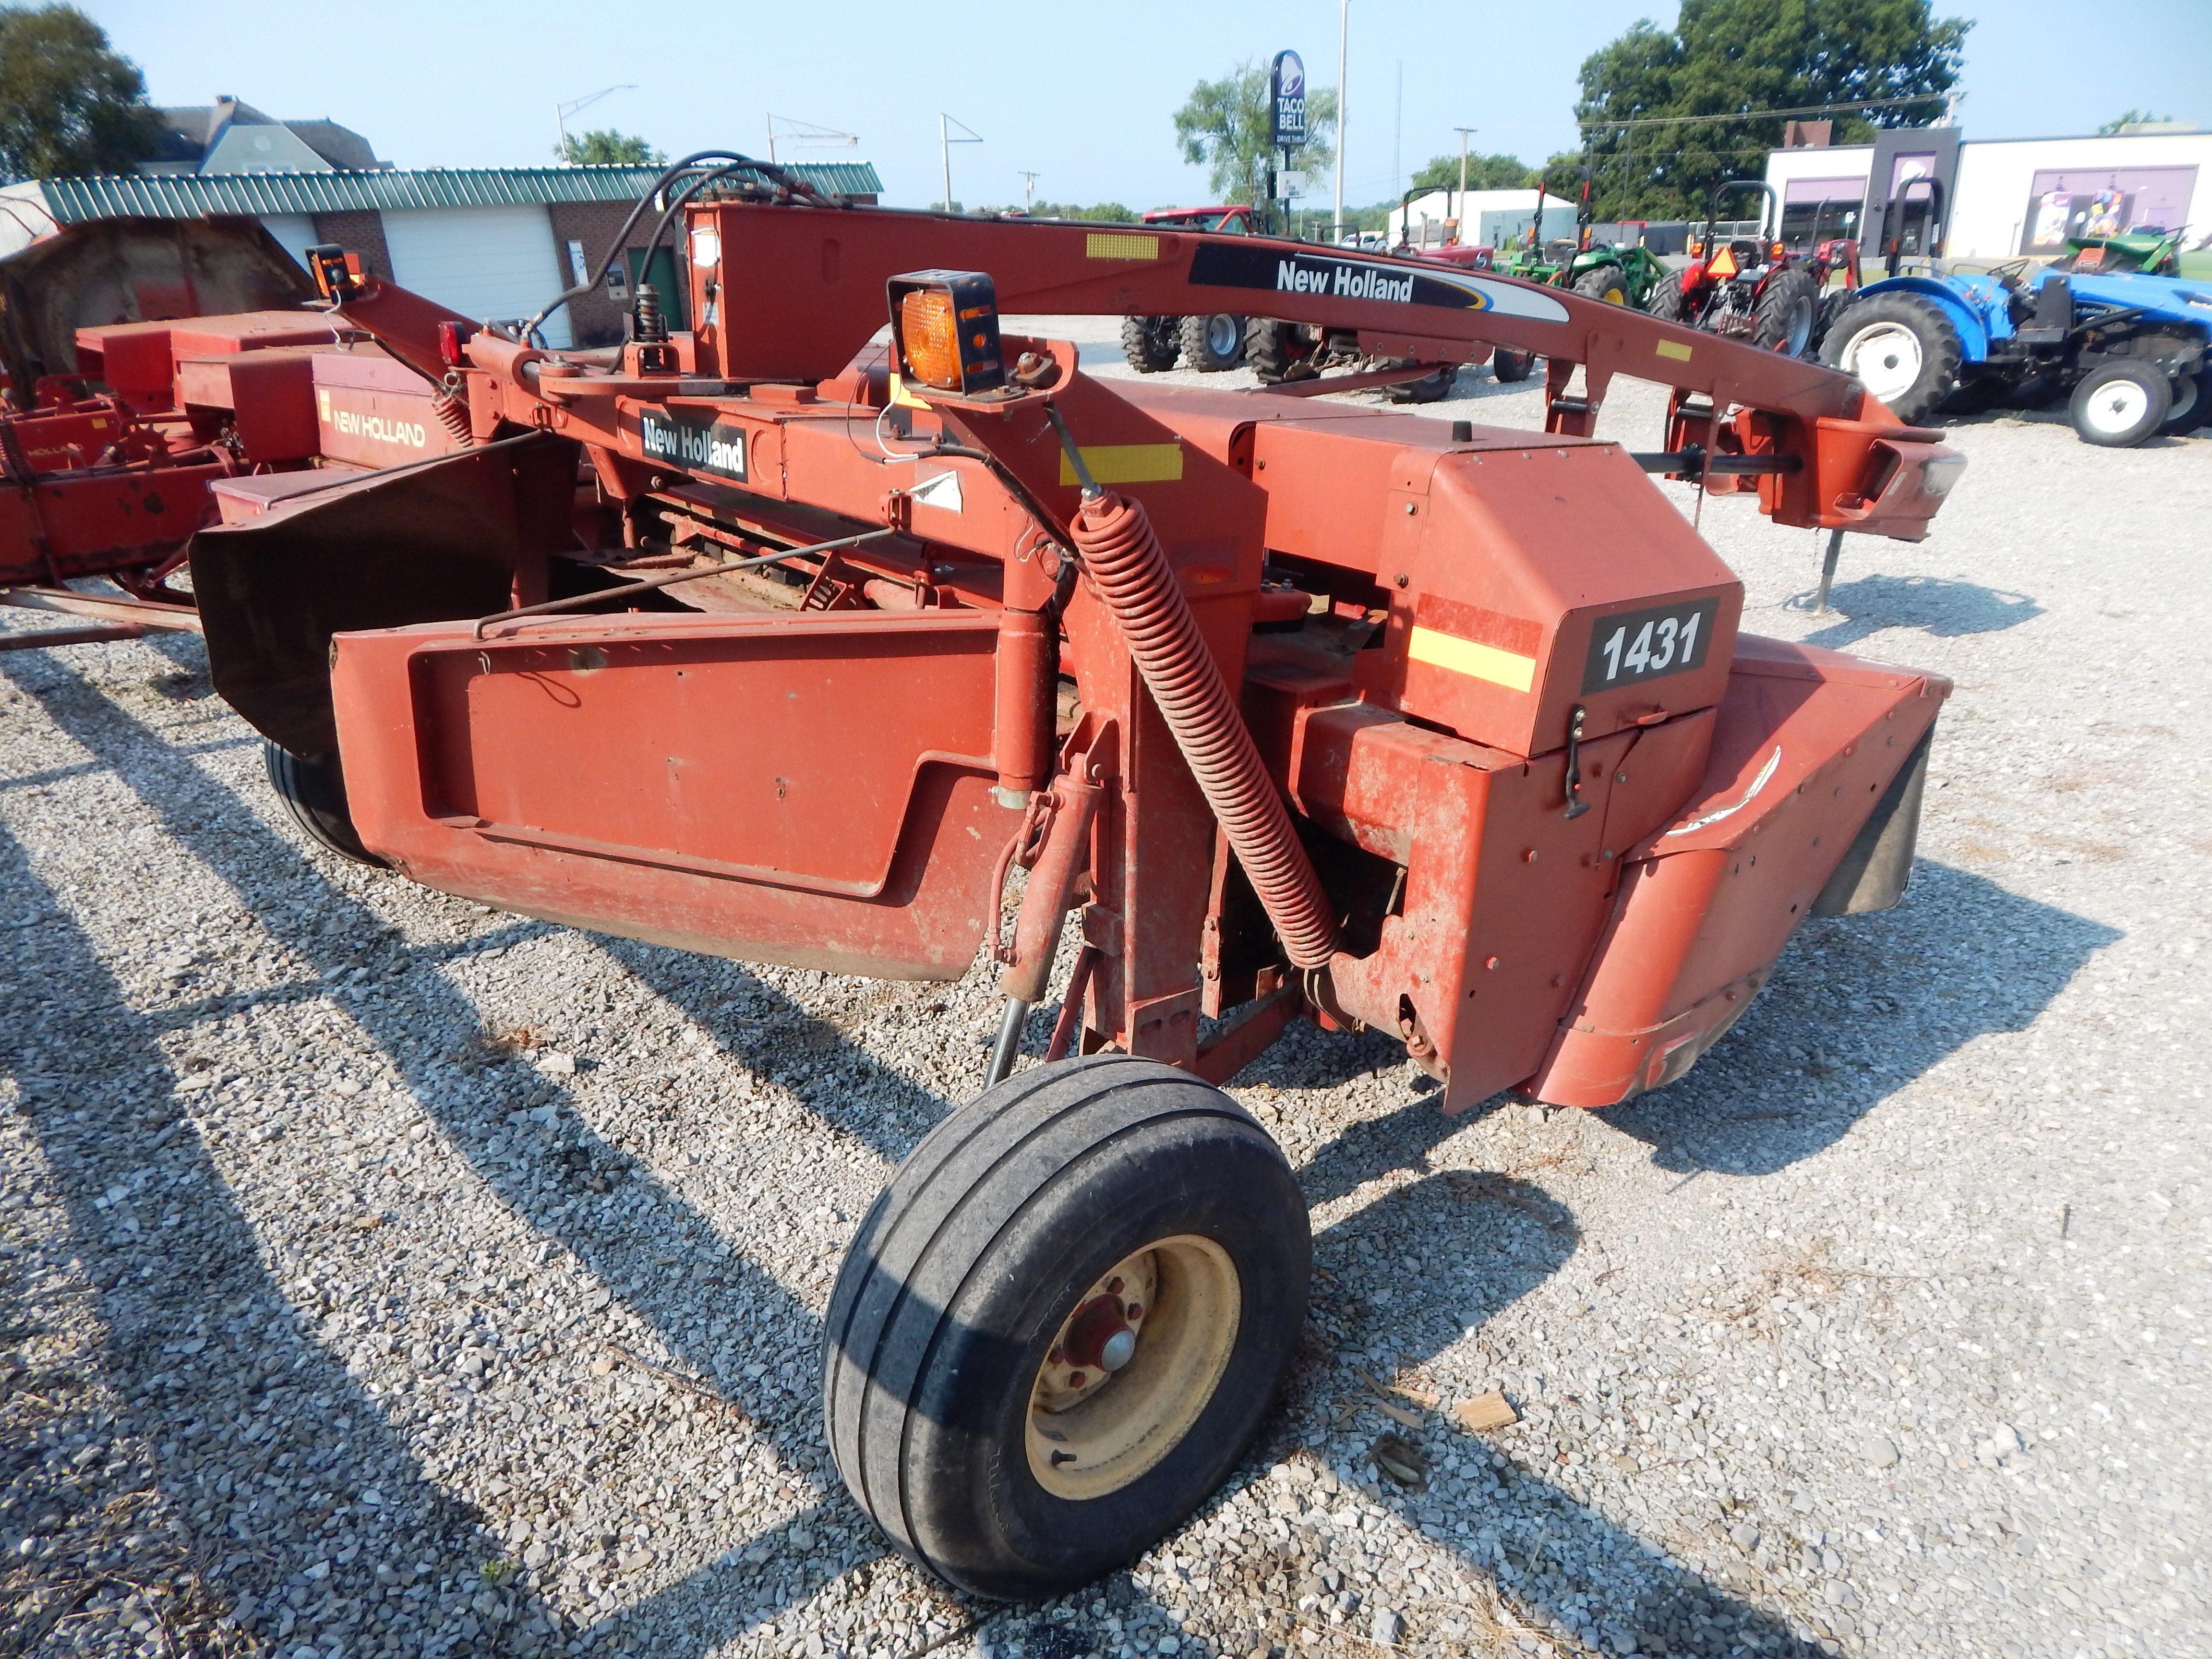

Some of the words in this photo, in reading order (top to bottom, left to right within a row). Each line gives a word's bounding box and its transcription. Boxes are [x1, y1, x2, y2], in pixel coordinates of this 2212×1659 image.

[1277, 97, 1305, 113] TACO
[1279, 114, 1304, 129] BELL
[1277, 260, 1329, 293] New
[1334, 265, 1414, 302] Holland
[334, 410, 360, 435] NEW
[362, 415, 425, 447] HOLLAND
[643, 417, 677, 455] New
[681, 425, 744, 473] Holland
[27, 444, 84, 457] HOLLAD
[1603, 612, 1701, 680] 1431
